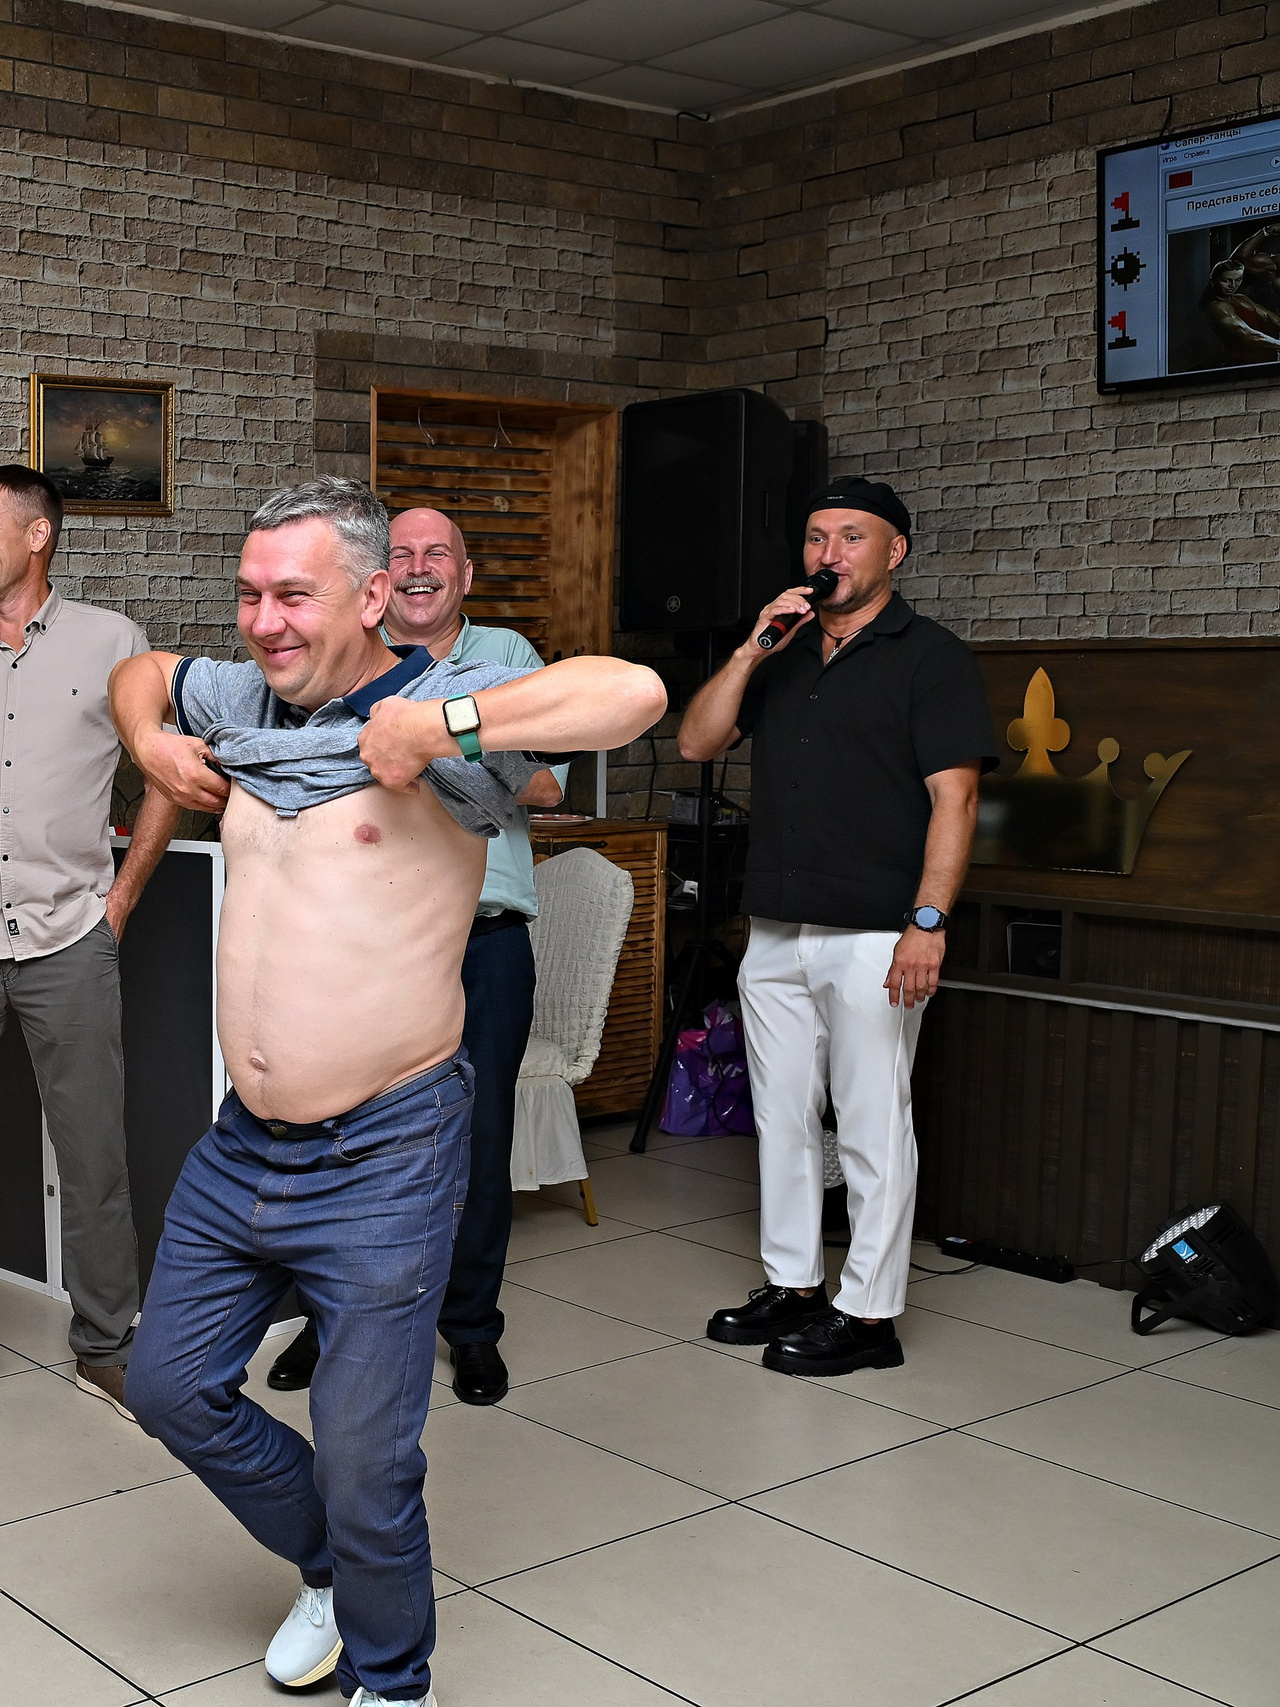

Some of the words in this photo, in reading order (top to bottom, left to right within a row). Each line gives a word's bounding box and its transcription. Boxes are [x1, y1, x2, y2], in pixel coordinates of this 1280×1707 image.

[1162, 155, 1178, 163] Игра
[1183, 149, 1211, 159] Справка
[1187, 190, 1257, 211] Представьте
[1258, 184, 1280, 198] себ
